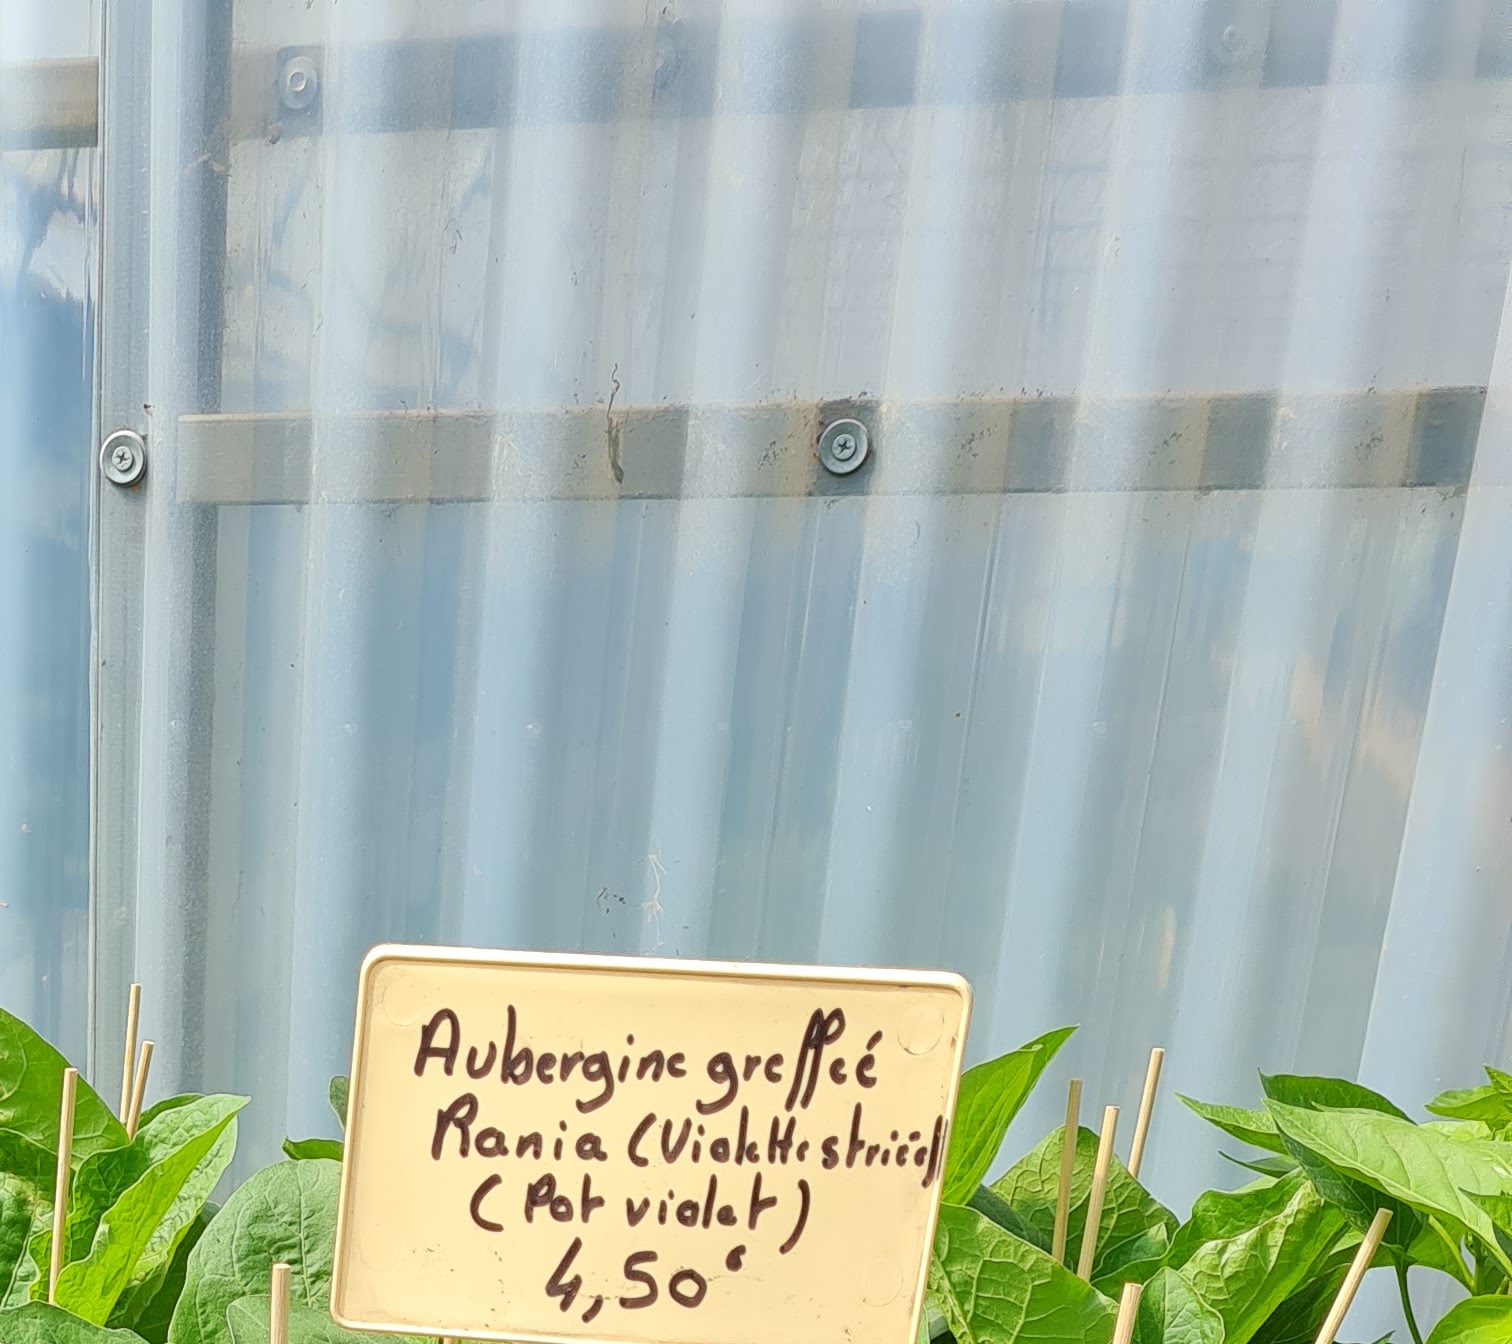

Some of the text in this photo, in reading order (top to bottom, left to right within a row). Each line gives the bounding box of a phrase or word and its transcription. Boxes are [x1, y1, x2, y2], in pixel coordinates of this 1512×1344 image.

[413, 1004, 687, 1116] Aubergine
[431, 1092, 609, 1164] Rania
[626, 1105, 811, 1168] (Violette
[468, 1171, 812, 1255] (Pot violet)
